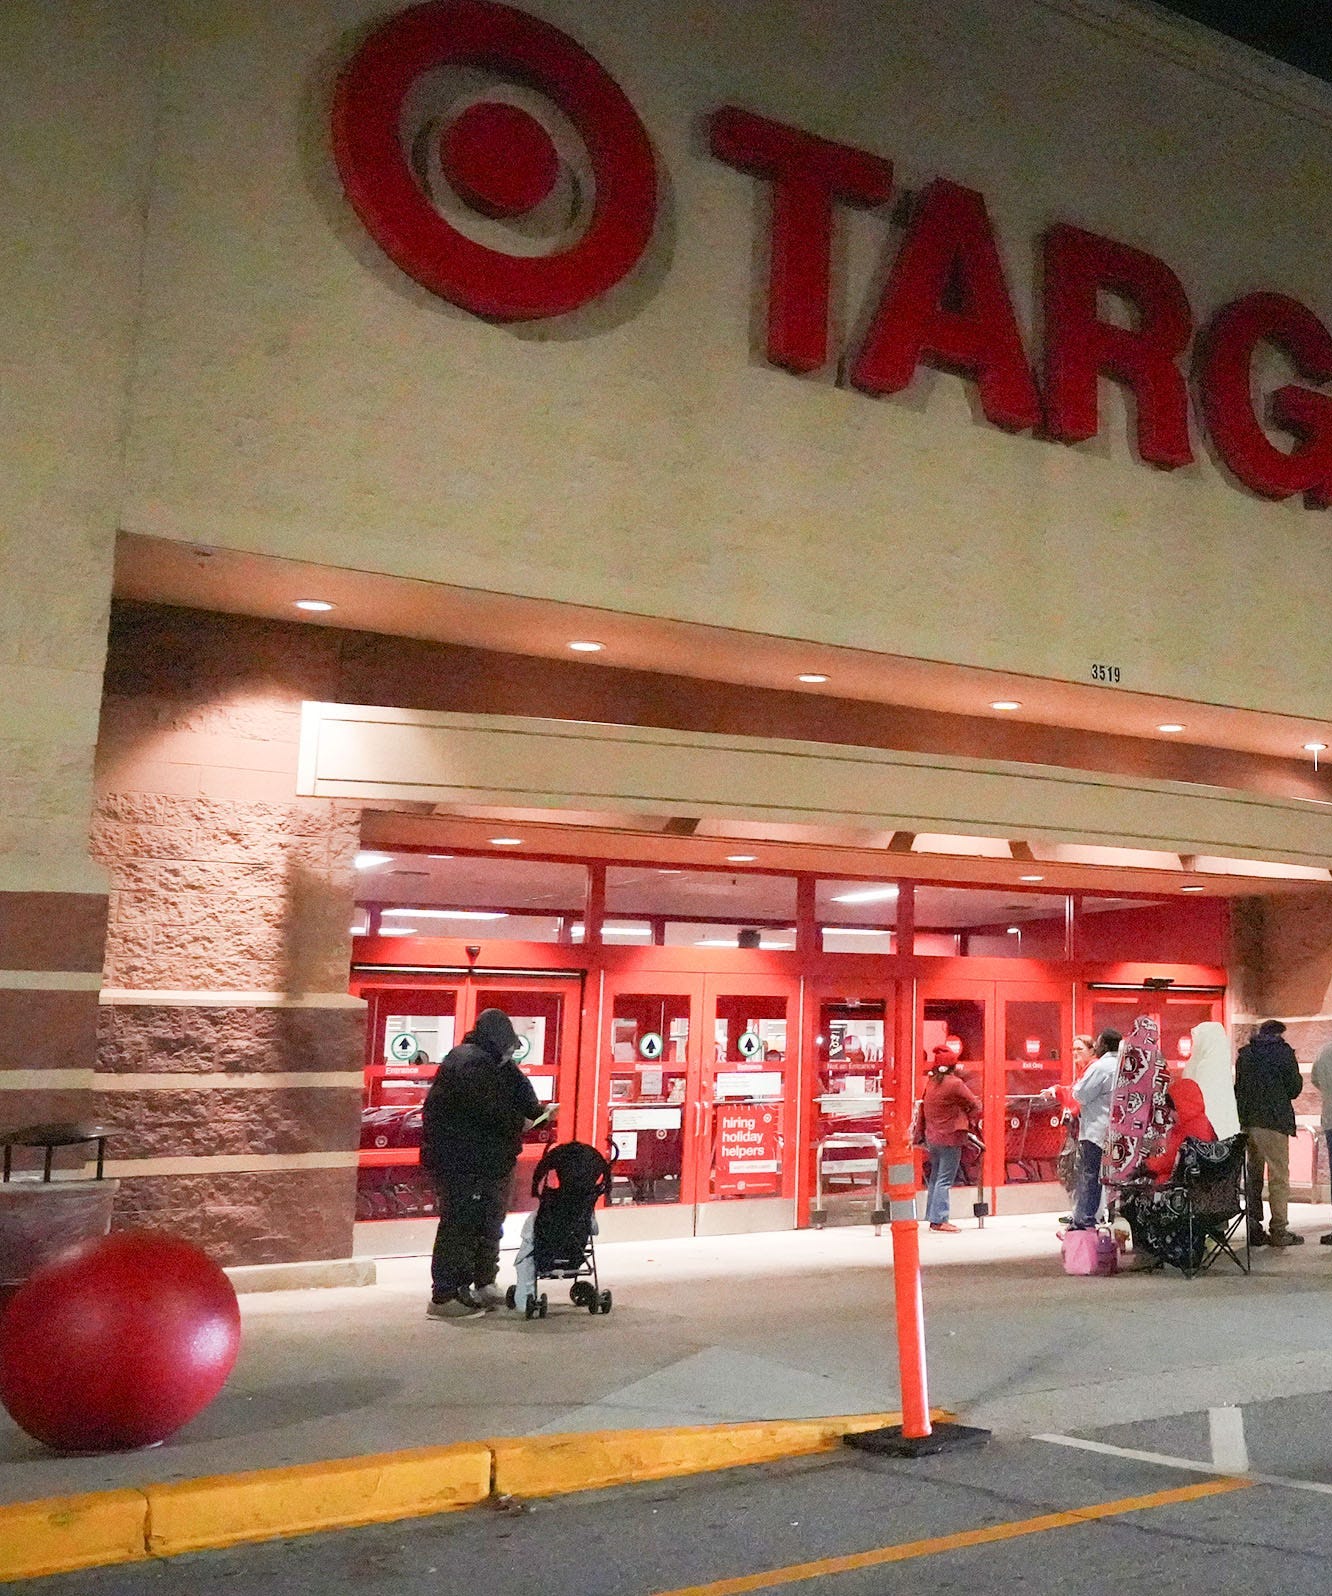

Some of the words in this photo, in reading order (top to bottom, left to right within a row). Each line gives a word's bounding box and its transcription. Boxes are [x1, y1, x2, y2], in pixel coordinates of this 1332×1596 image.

[1091, 664, 1121, 683] 3519
[385, 1066, 419, 1075] Entrance
[722, 1117, 756, 1131] hiring
[722, 1131, 764, 1144] holiday
[721, 1145, 765, 1158] helpers
